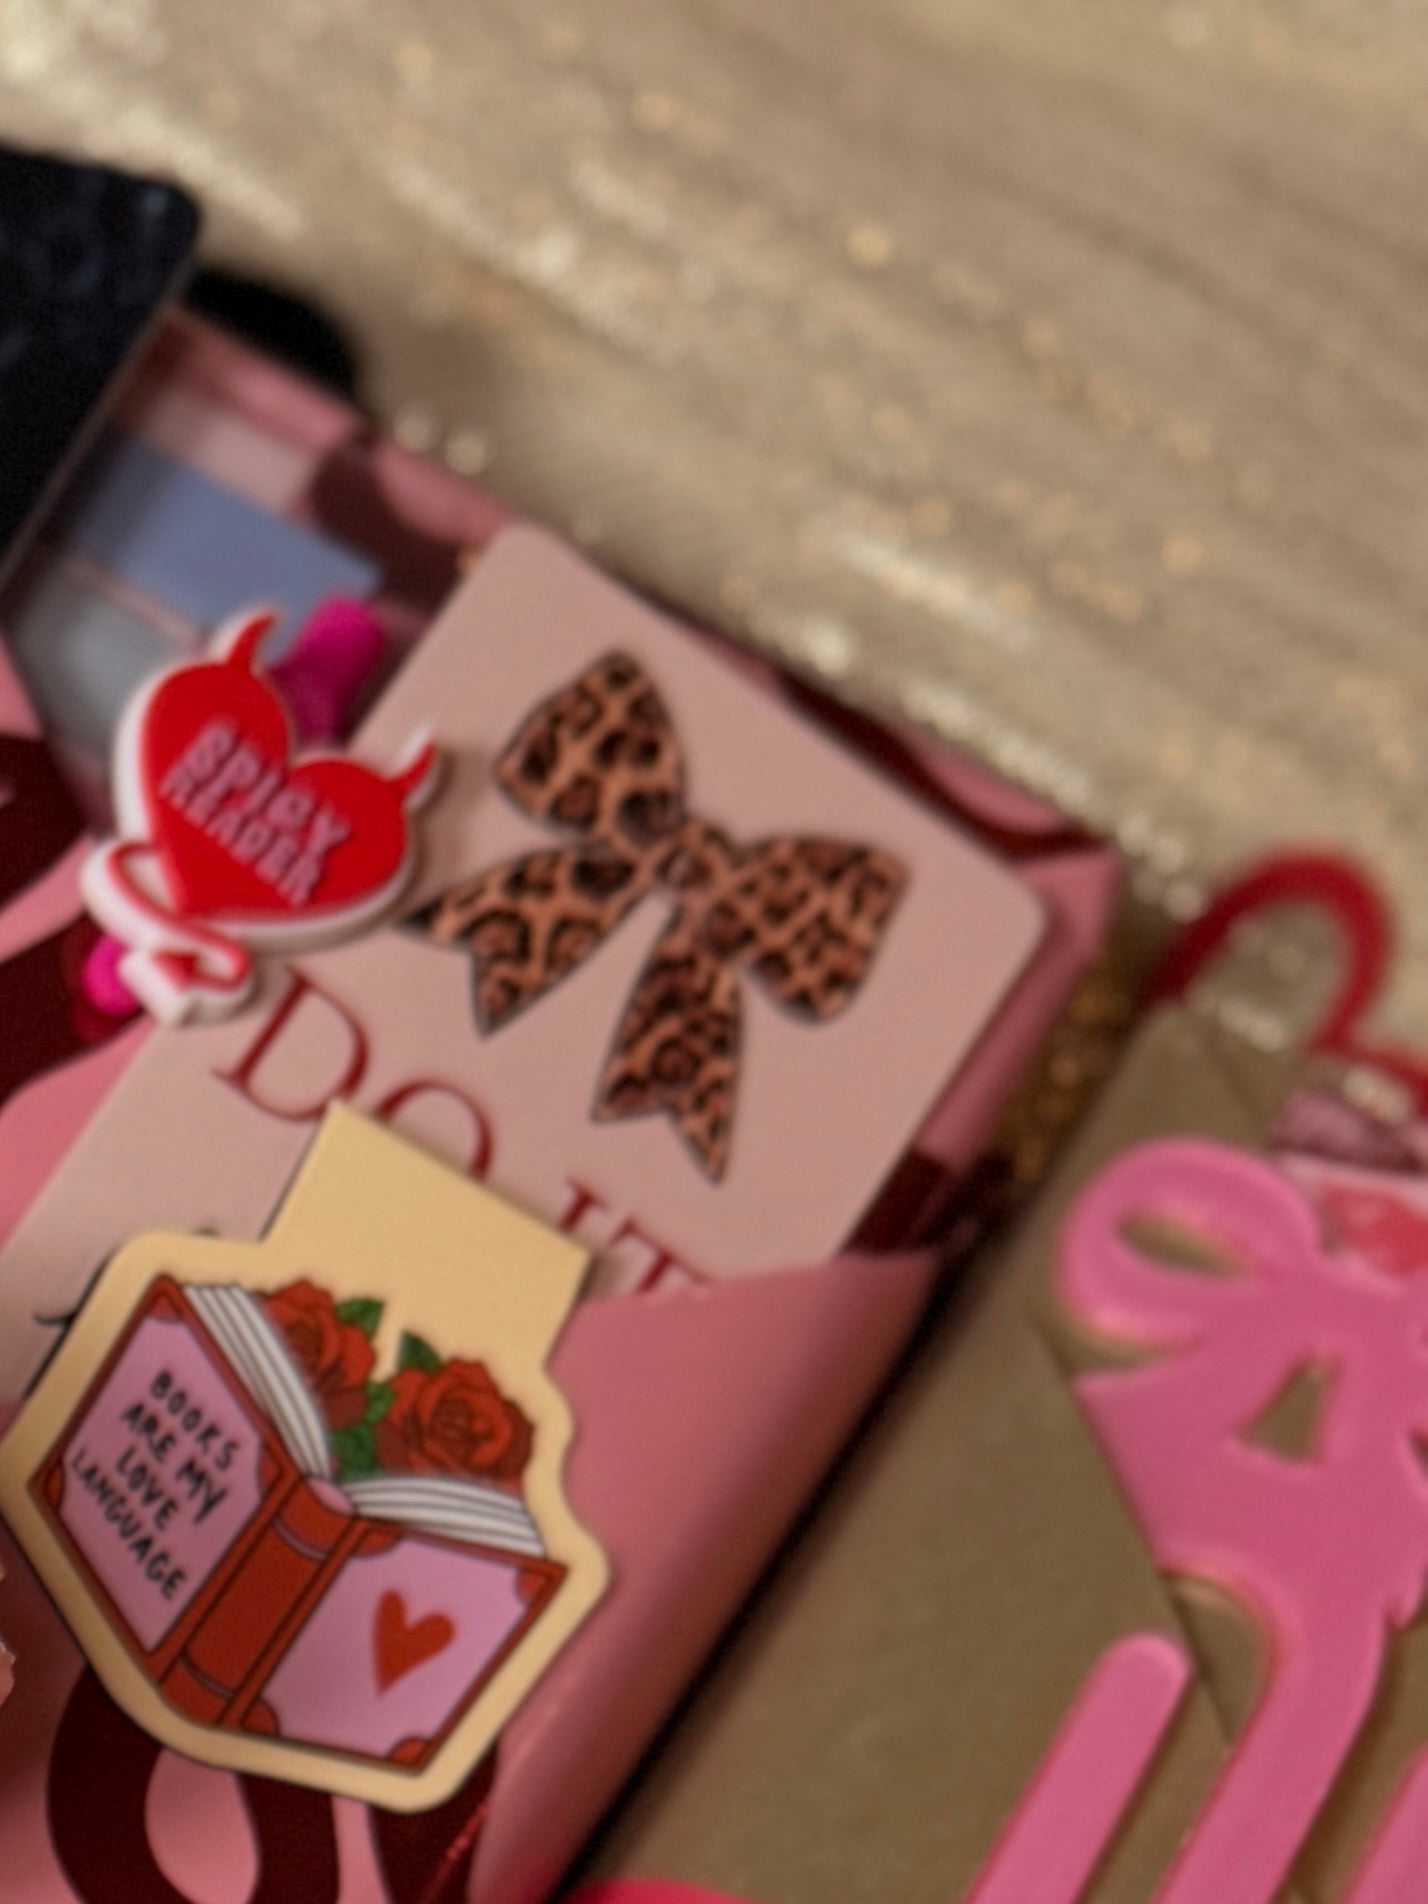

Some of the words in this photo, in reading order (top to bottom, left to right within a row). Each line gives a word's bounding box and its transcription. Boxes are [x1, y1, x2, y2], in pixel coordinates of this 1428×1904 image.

[120, 1403, 175, 1464] ARE
[175, 1459, 227, 1525] MY
[151, 1370, 238, 1471] BOOKS
[72, 1447, 185, 1601] LANGUAGE
[116, 1447, 178, 1531] LOVE
